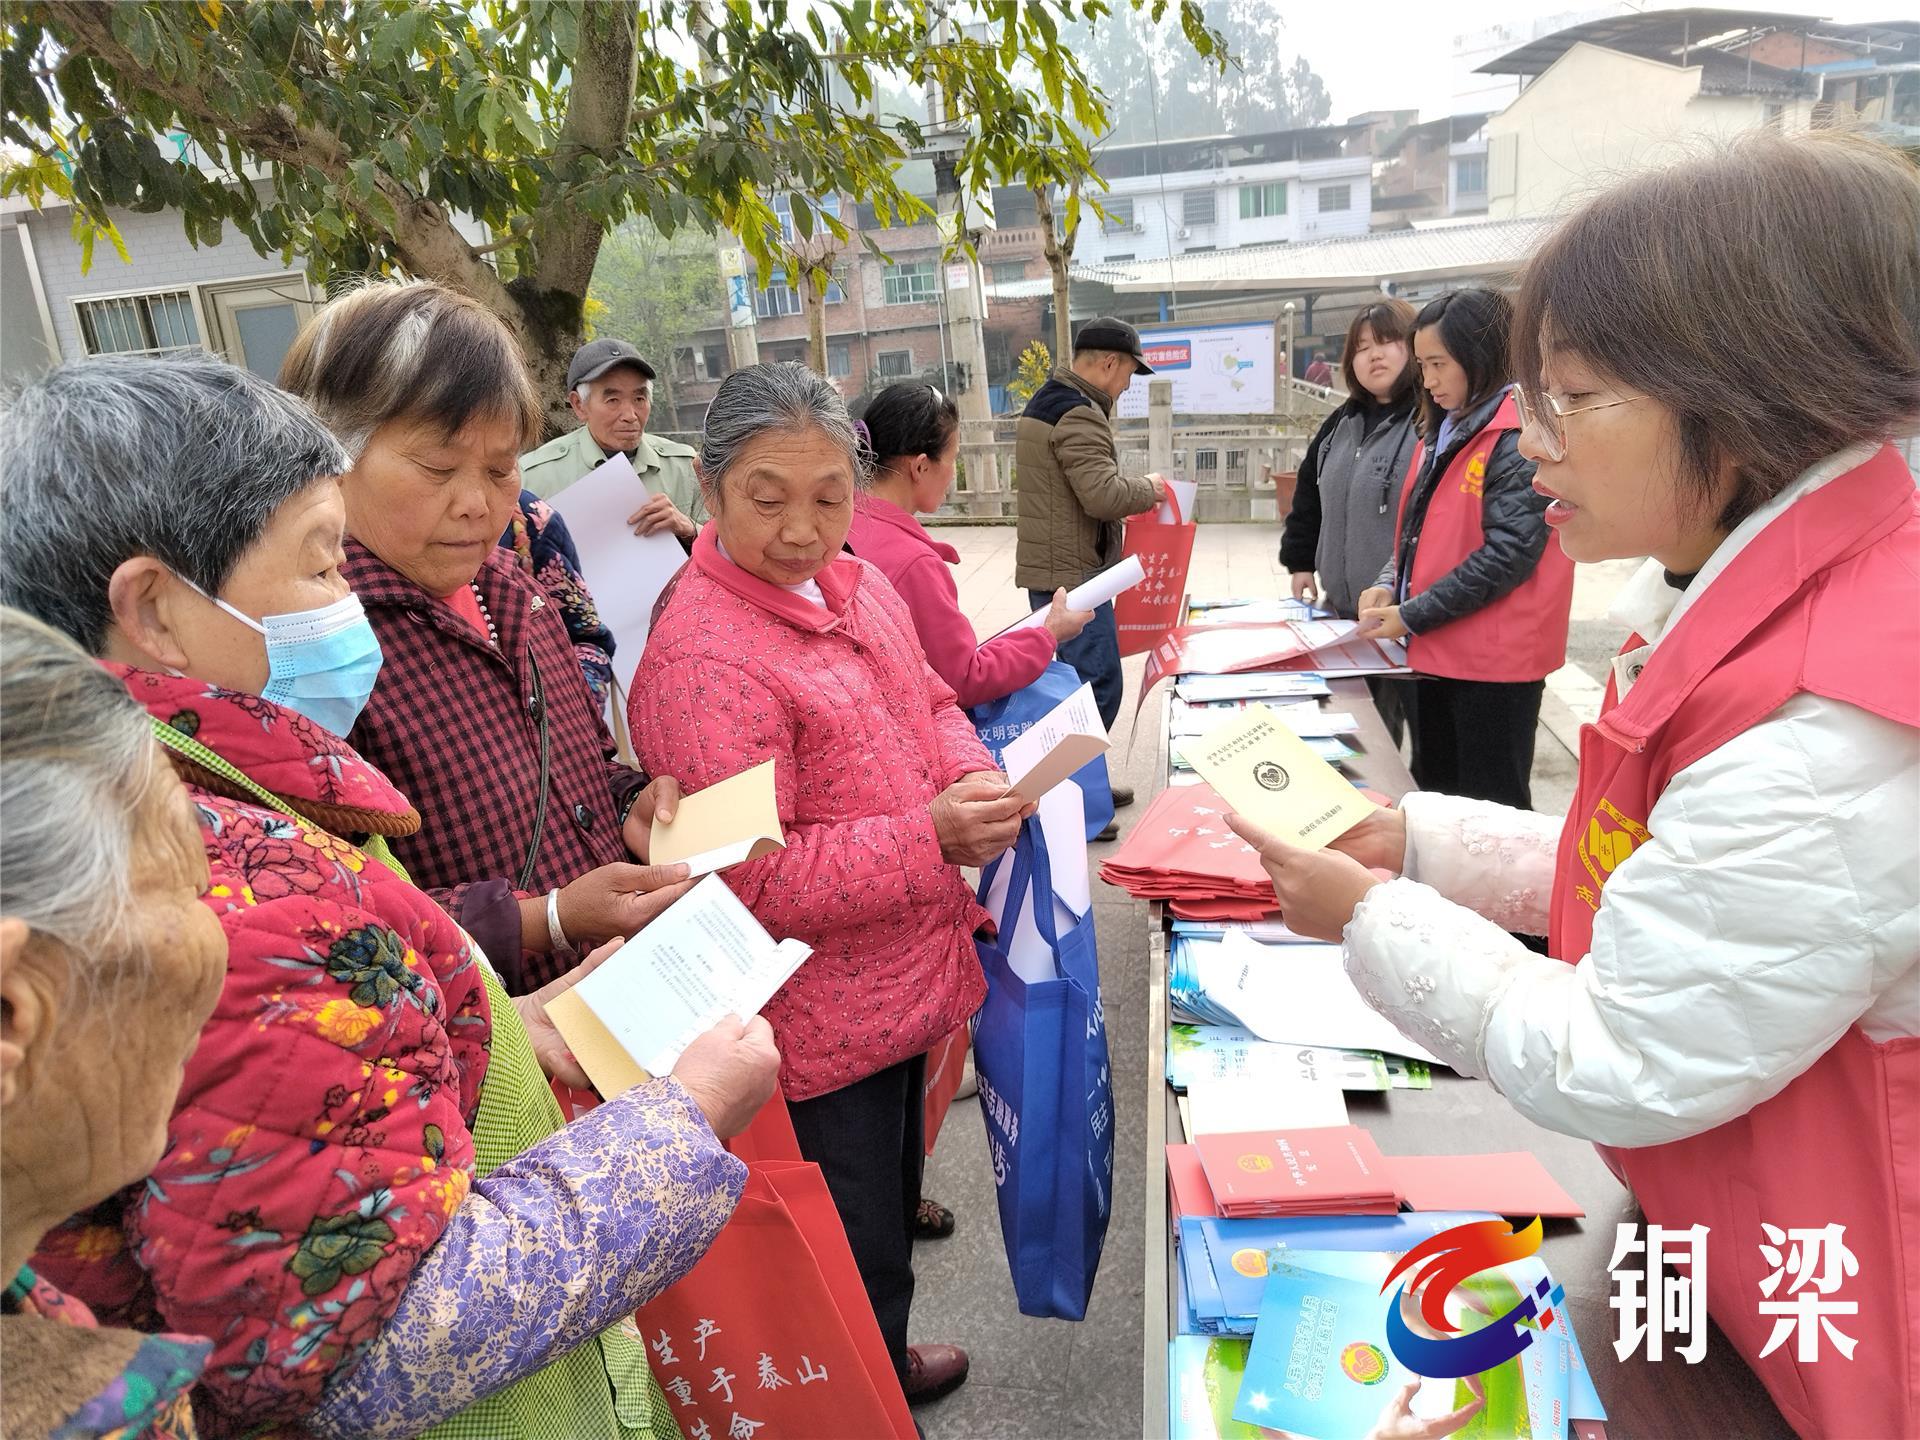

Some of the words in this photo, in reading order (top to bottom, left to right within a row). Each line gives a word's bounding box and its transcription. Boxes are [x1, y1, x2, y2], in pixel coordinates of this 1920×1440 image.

[651, 1317, 722, 1366] 生产
[664, 1352, 829, 1407] 重于泰山
